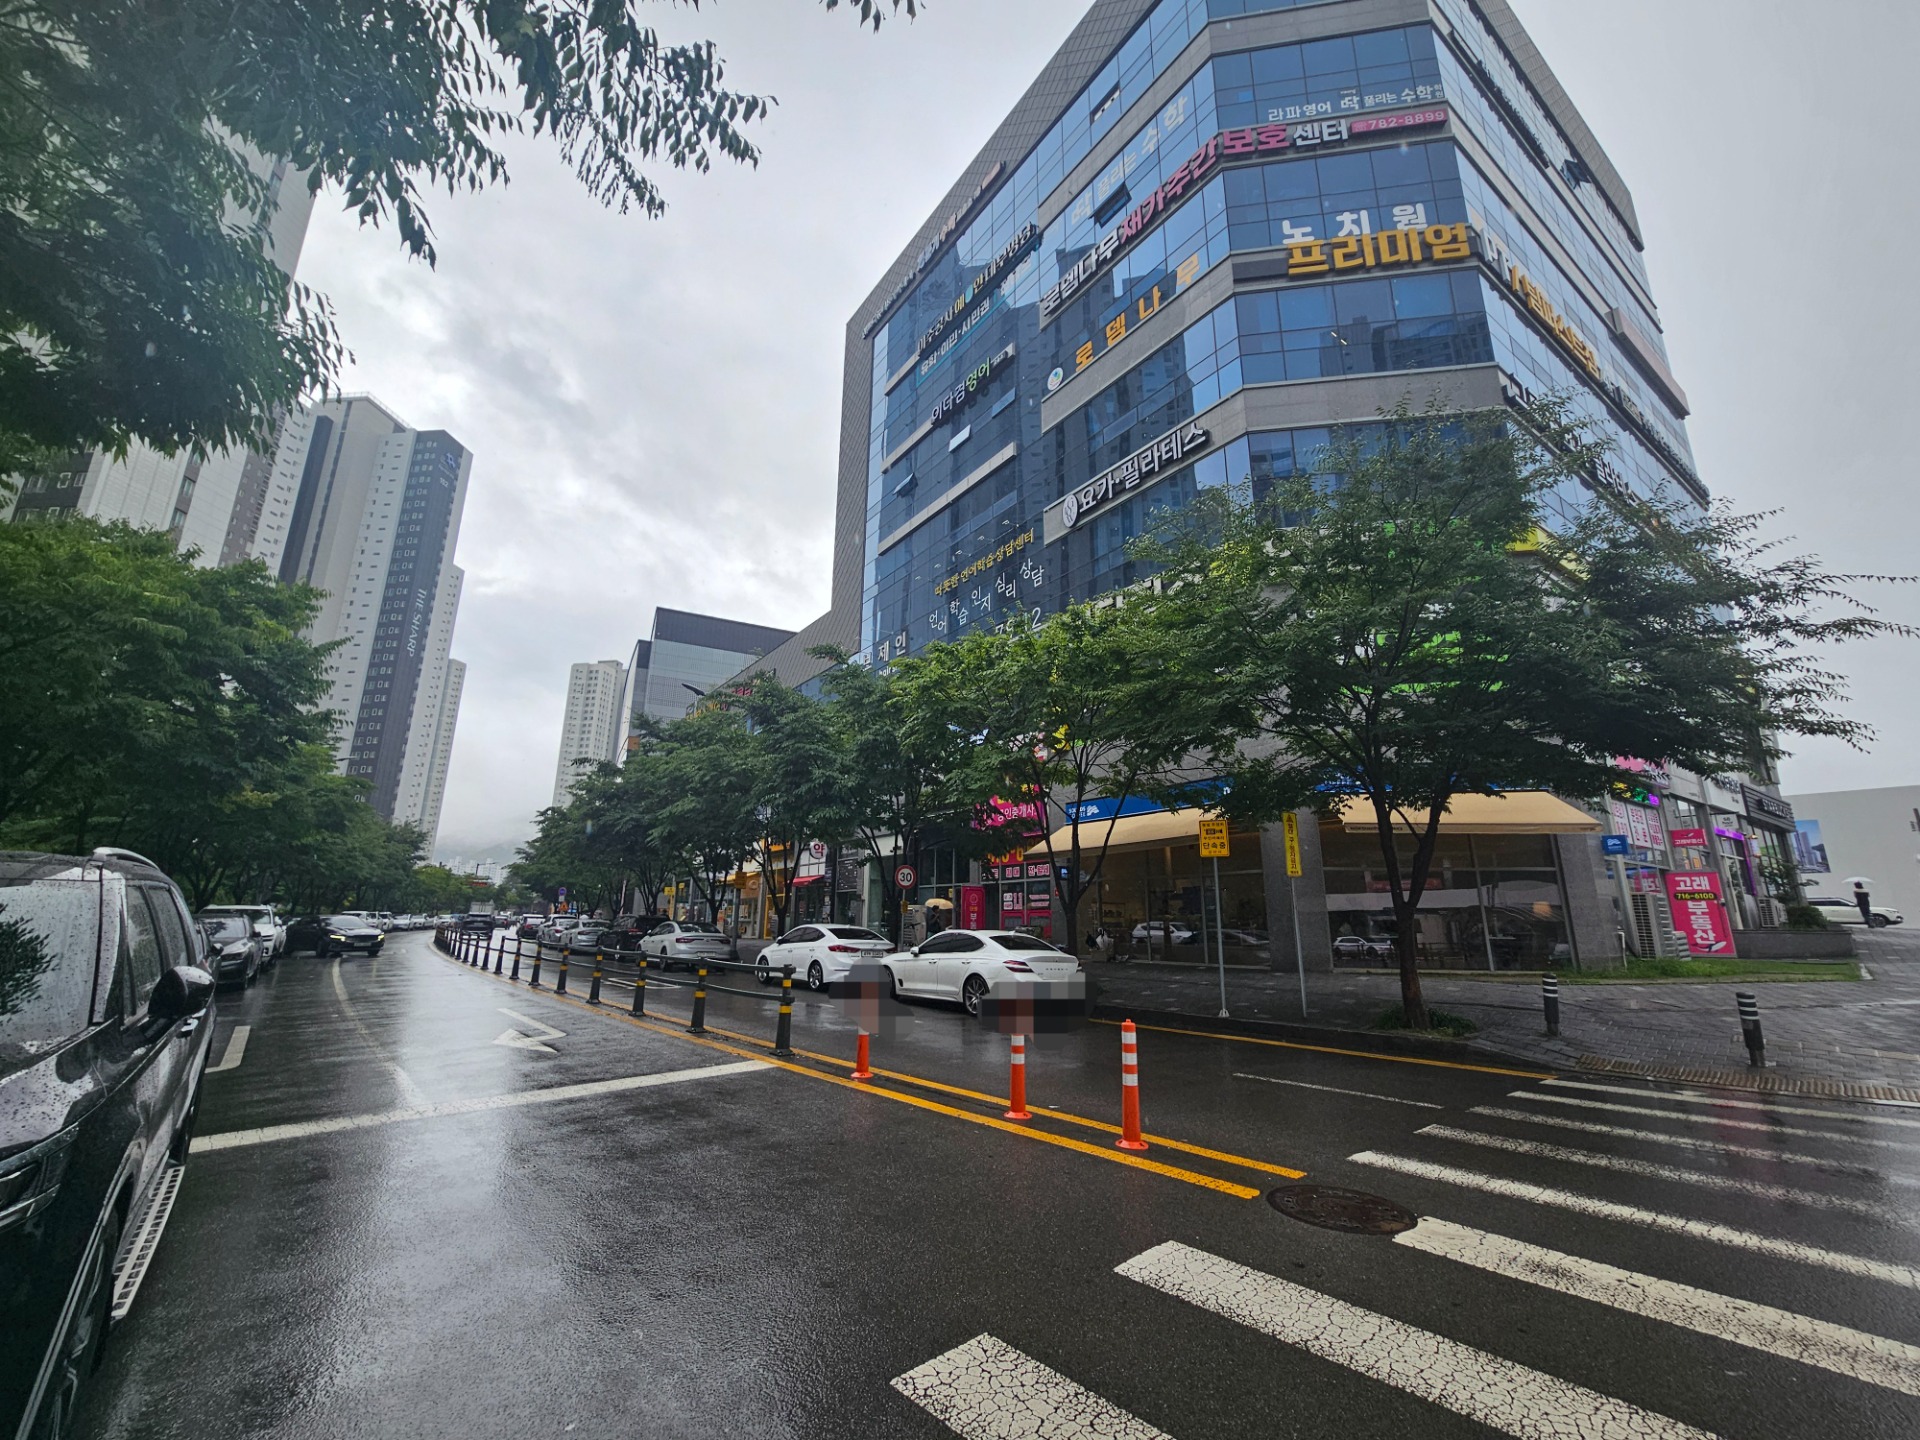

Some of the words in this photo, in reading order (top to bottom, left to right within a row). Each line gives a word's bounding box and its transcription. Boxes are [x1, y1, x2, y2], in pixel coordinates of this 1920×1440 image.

[1268, 101, 1332, 122] 라파영어
[1363, 92, 1397, 107] 풀리는
[1368, 110, 1445, 131] 782-8899
[1282, 202, 1428, 246] 노치원
[1286, 223, 1471, 276] 프리미엄
[1075, 254, 1200, 372] 로뎀나무
[995, 572, 1016, 598] 심리
[1019, 557, 1045, 588] 상담
[416, 588, 427, 612] THE
[406, 612, 422, 657] SHARP
[1203, 841, 1227, 850] 단속중
[899, 872, 912, 882] 30
[1674, 876, 1711, 891] 고래
[1687, 900, 1717, 945] 부동산
